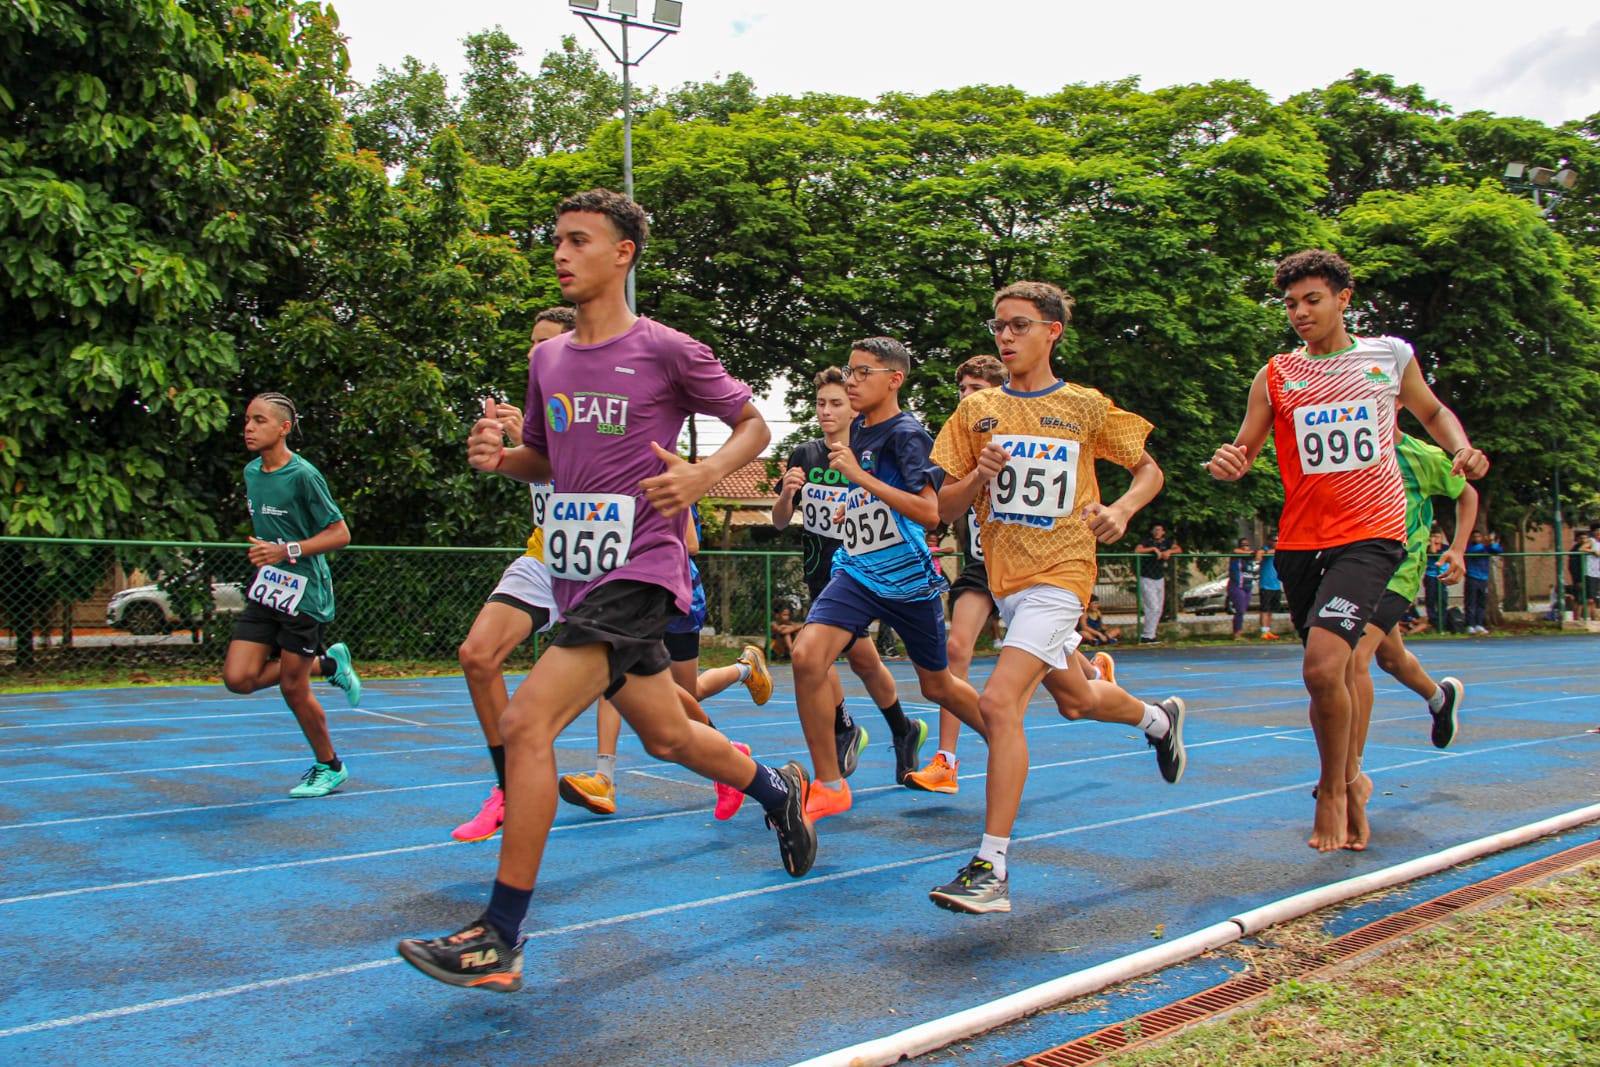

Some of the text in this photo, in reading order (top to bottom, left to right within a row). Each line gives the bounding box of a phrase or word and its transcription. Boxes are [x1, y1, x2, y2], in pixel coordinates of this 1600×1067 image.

[573, 397, 628, 426] EAFI
[1305, 406, 1369, 426] CAIXA
[597, 423, 625, 435] SEDES
[1303, 427, 1374, 467] 996
[807, 488, 847, 502] CAIXA
[996, 465, 1068, 509] 951
[553, 502, 620, 521] CAIXA
[845, 508, 895, 549] 952
[550, 529, 622, 575] 956
[264, 570, 299, 590] CAIXA
[254, 584, 296, 613] 954
[1326, 596, 1359, 616] NIKE
[1340, 619, 1355, 631] SB
[460, 948, 498, 970] FILA
